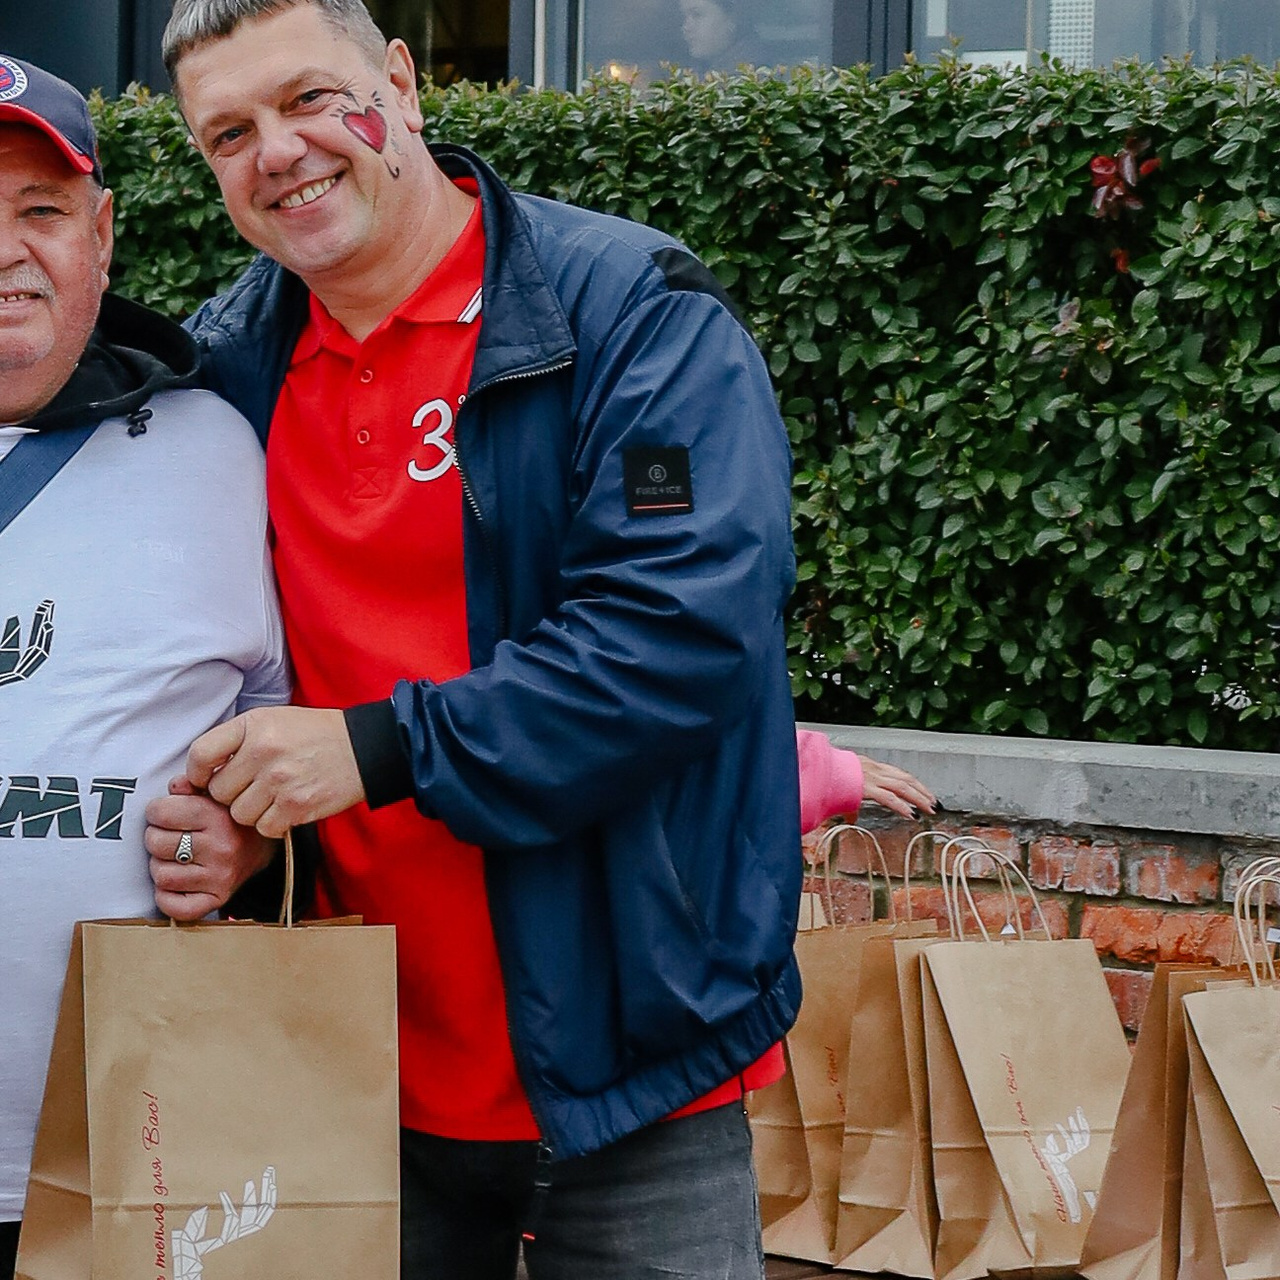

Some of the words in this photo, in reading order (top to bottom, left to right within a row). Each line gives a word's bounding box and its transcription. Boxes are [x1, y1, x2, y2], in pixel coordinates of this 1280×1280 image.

[407, 398, 455, 482] 3
[142, 1091, 161, 1151] Вас!
[152, 1157, 169, 1196] для
[153, 1203, 167, 1269] тепло
